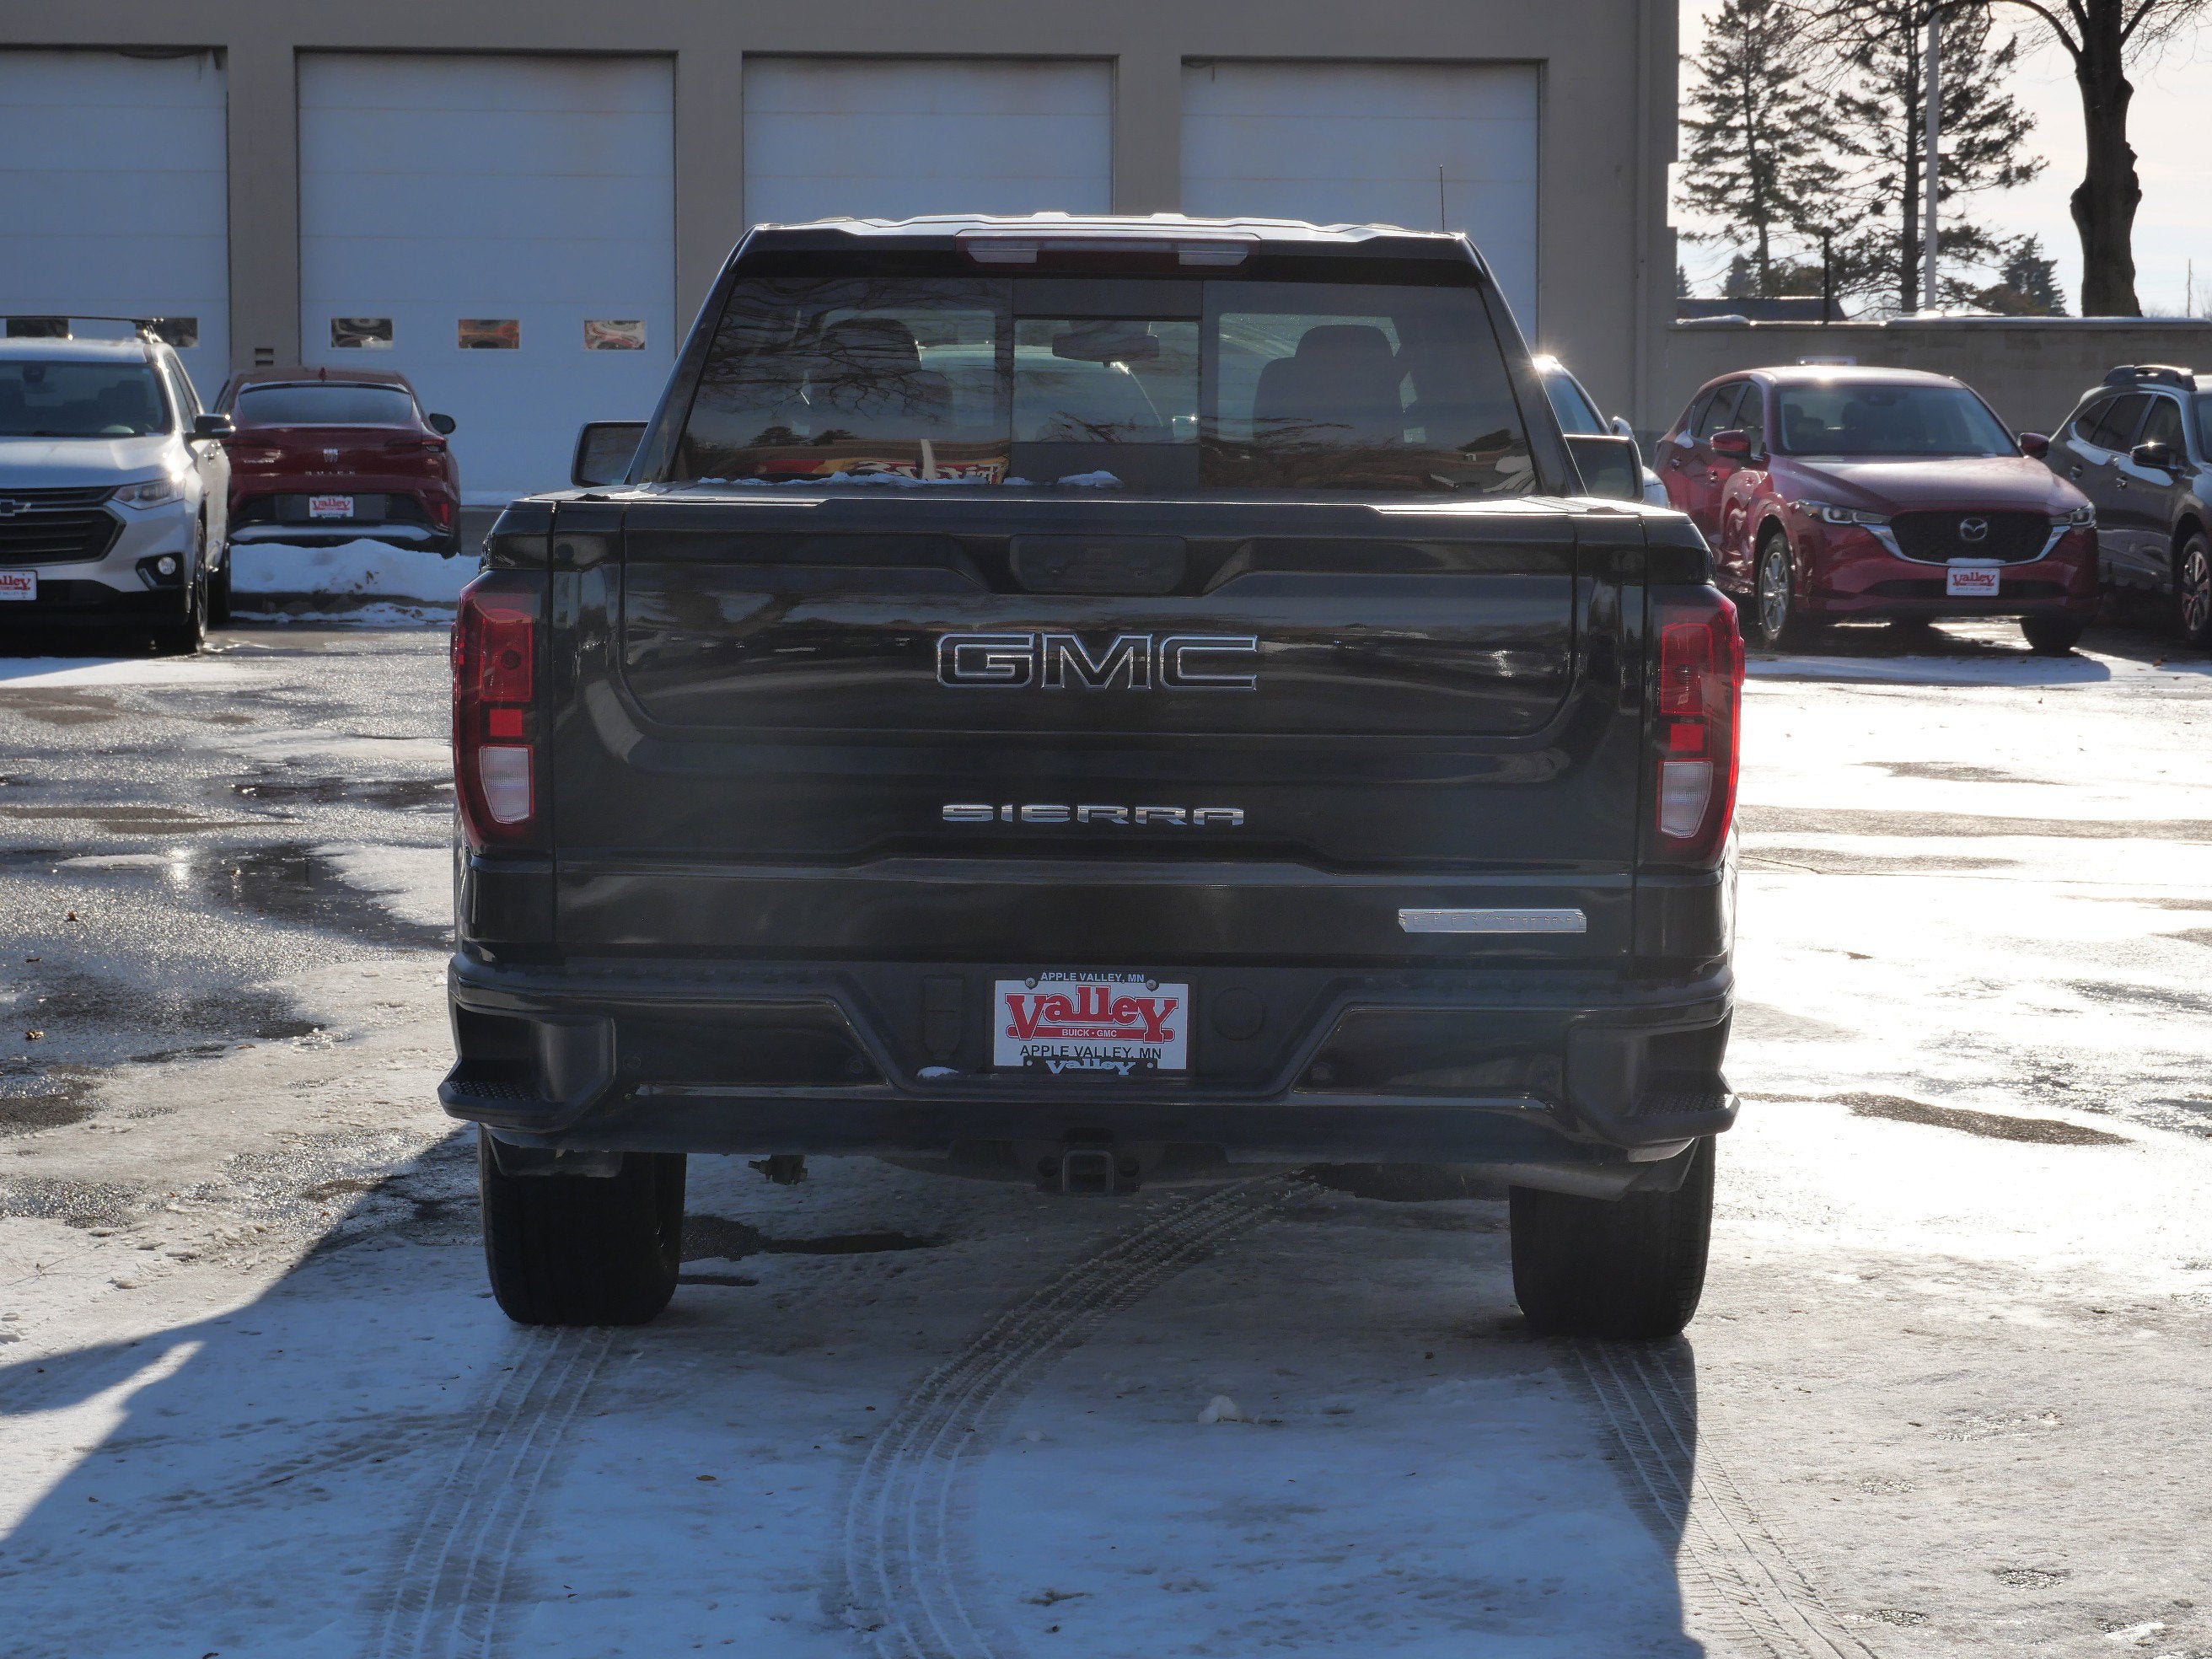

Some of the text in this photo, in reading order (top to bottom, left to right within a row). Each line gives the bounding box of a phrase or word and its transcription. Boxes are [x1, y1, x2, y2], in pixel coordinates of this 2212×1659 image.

[937, 633, 1259, 690] GMC
[942, 804, 1244, 826] SIERRA
[1040, 971, 1145, 984] APPLE VALLEY, MN
[1062, 1028, 1117, 1038] BUICK GMC
[1019, 1044, 1070, 1057] APPLE
[1139, 1047, 1162, 1060] MN
